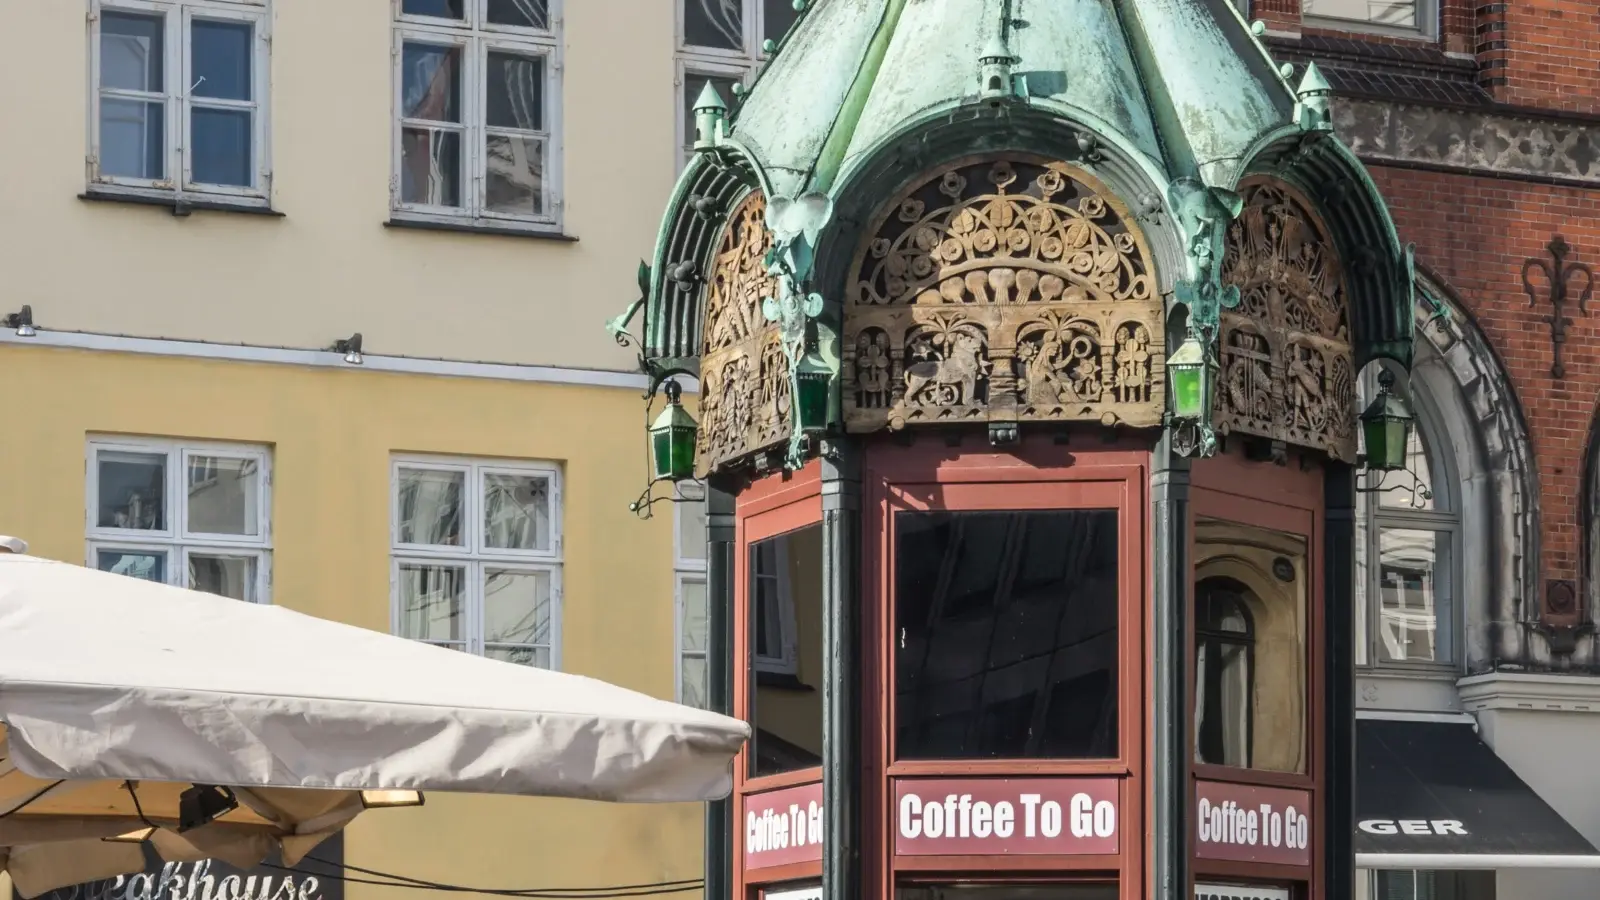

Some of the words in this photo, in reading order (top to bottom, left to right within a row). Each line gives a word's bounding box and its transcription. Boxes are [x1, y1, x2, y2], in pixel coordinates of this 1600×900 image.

[747, 808, 789, 853] Coffee
[789, 803, 806, 846] To
[899, 793, 1015, 838] Coffee
[1020, 793, 1062, 838] To
[1070, 792, 1115, 838] Go
[1199, 797, 1258, 846] Coffee
[1260, 803, 1282, 847] To
[1285, 805, 1308, 849] Go
